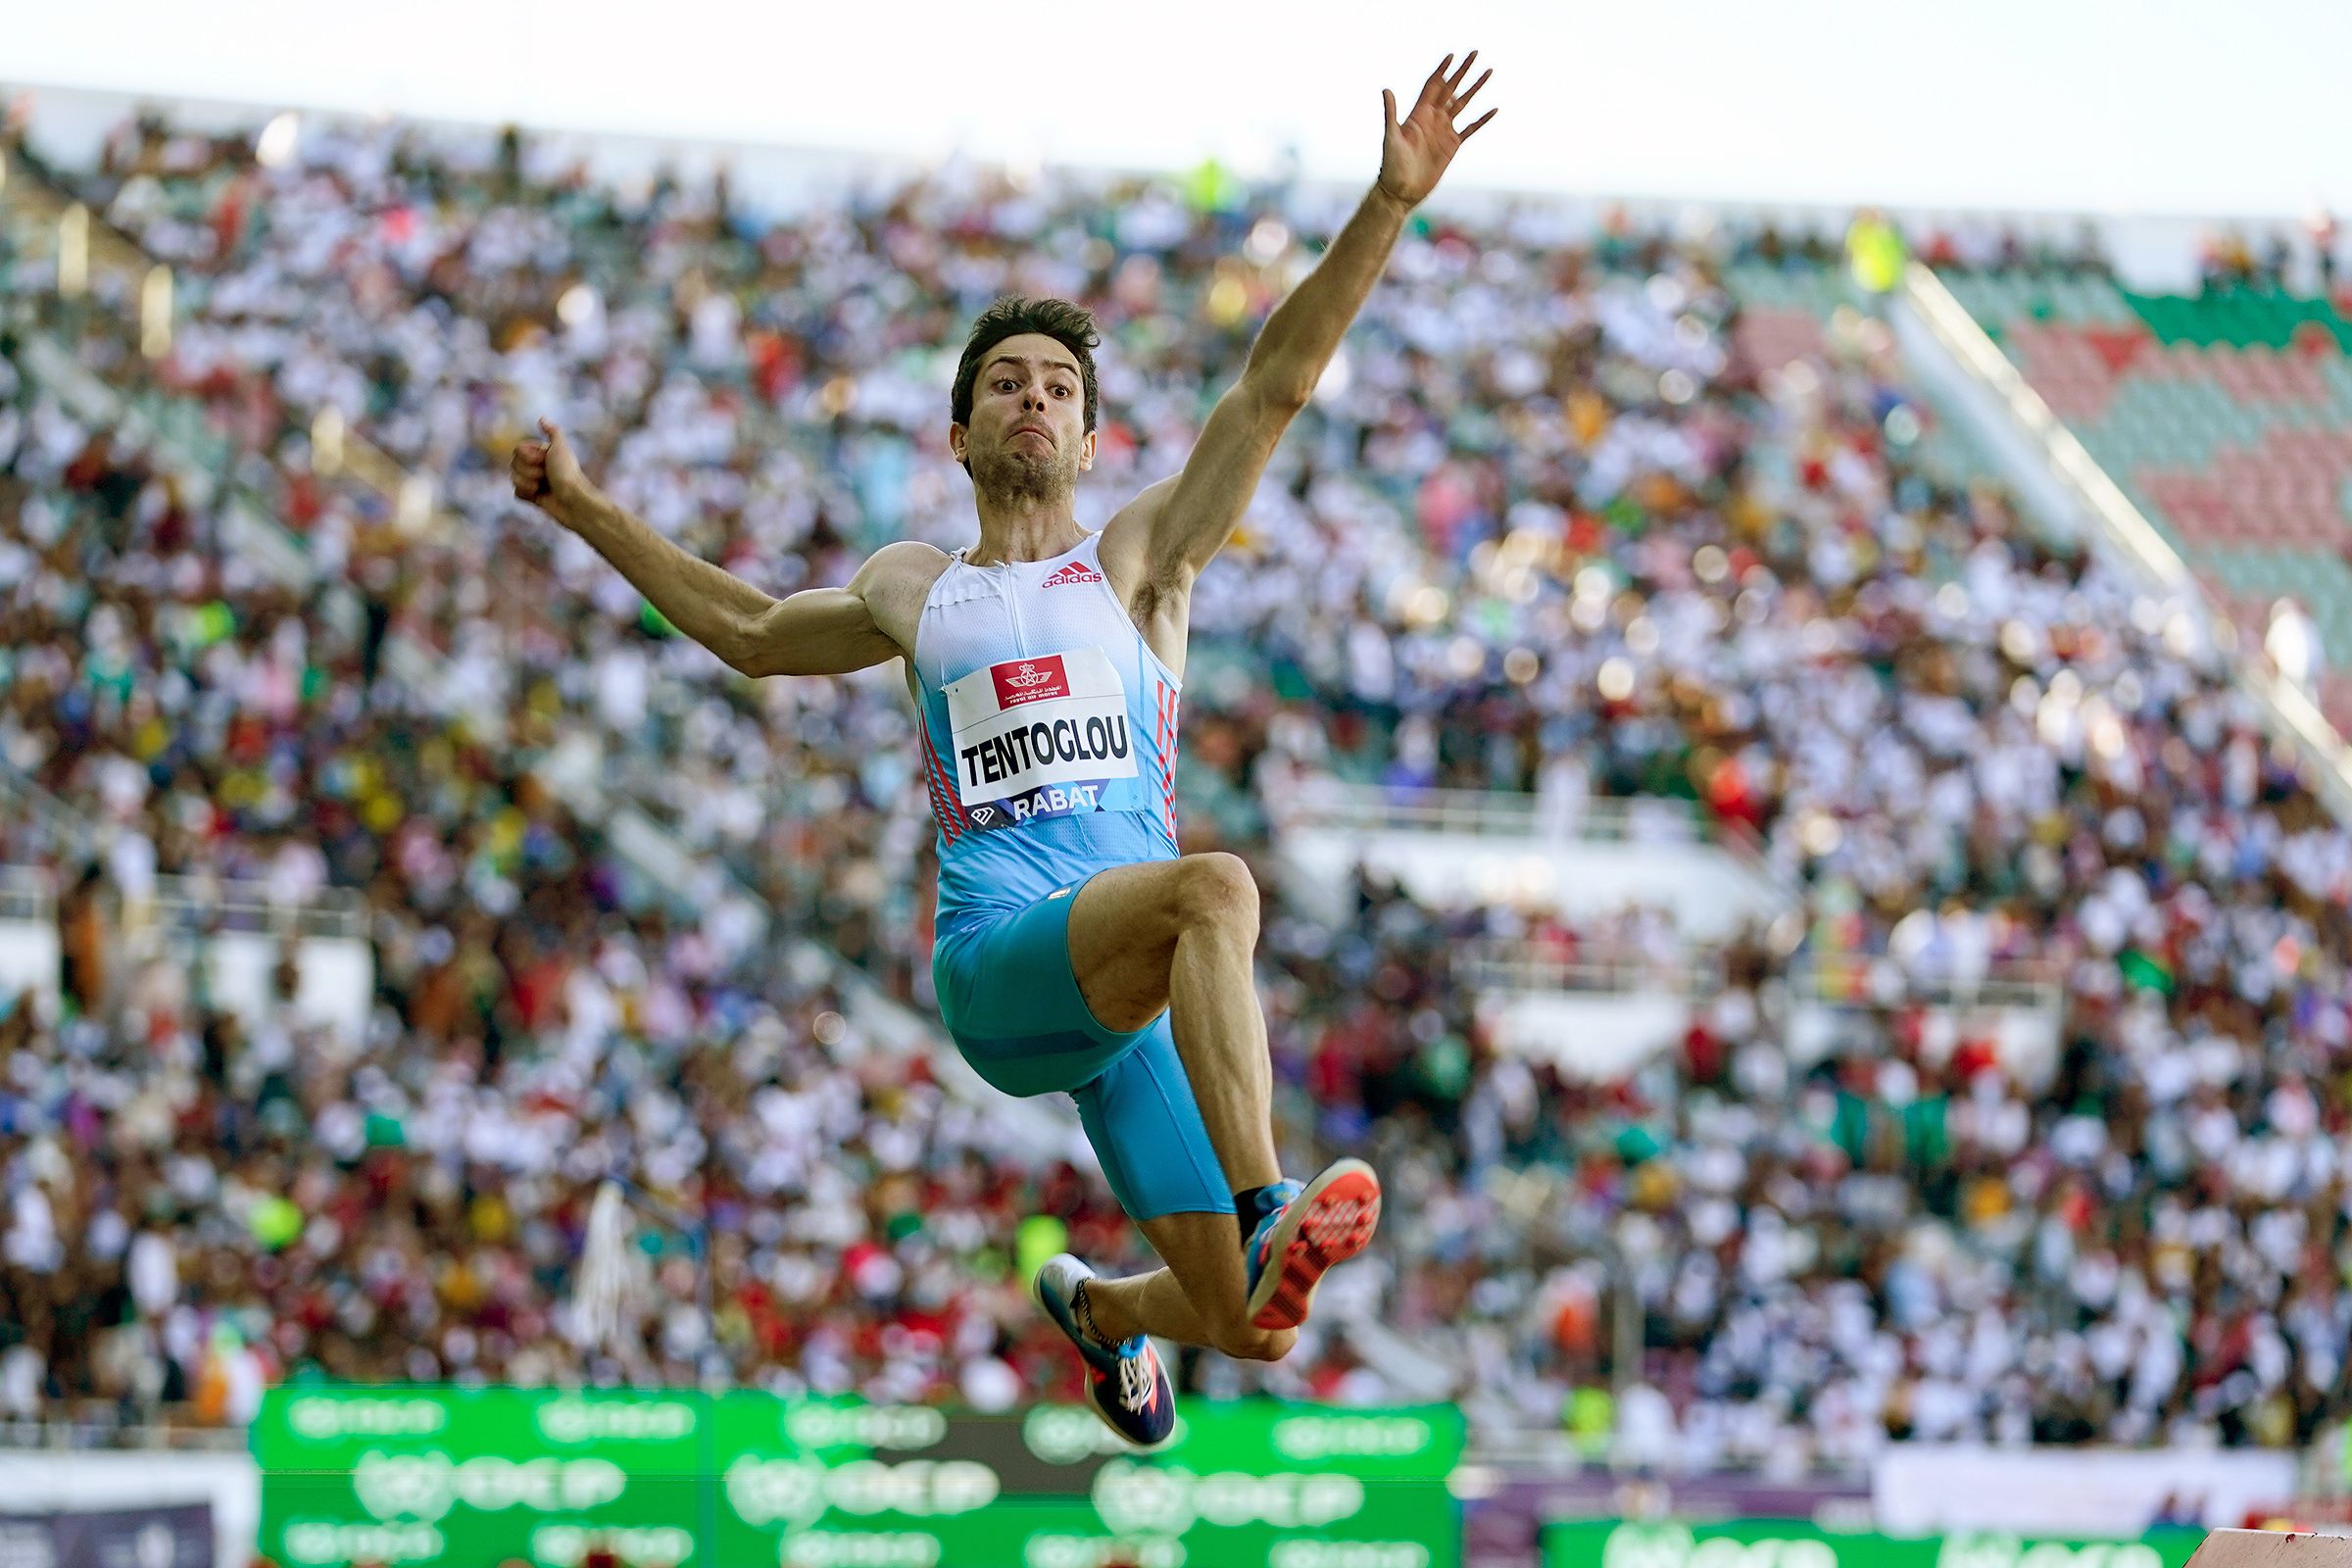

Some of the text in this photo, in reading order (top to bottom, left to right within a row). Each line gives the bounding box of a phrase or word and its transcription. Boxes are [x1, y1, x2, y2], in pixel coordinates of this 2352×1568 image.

[1042, 572, 1102, 589] adidas
[961, 715, 1128, 786] TENTOGLOU
[1013, 785, 1099, 820] RABAT
